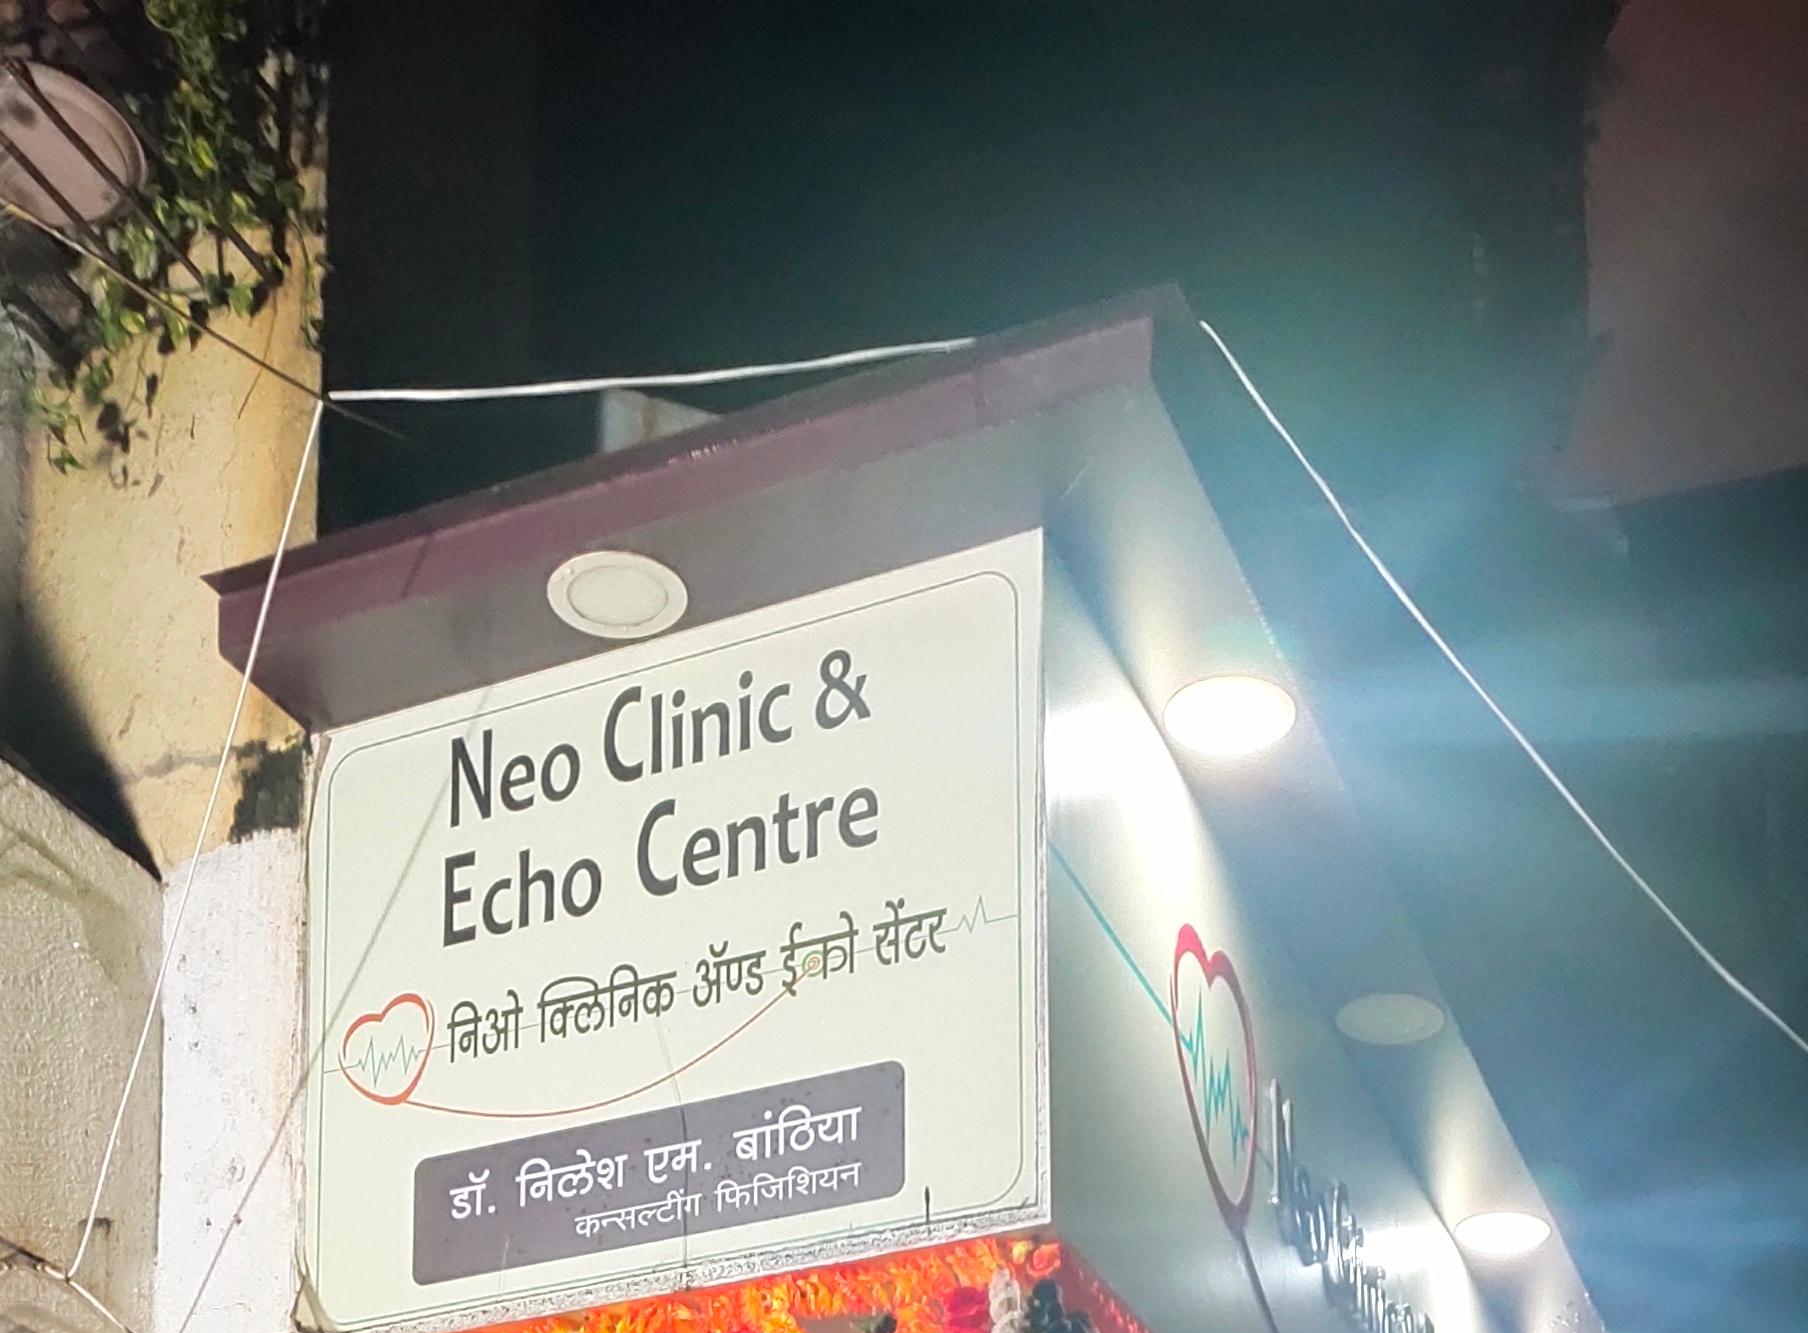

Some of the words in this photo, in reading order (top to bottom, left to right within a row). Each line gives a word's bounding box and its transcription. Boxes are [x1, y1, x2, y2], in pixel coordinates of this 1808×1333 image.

[449, 729, 580, 827] Neo
[603, 671, 791, 782] Clinic
[815, 649, 872, 731] &
[442, 846, 602, 947] Echo
[636, 784, 878, 896] Centre
[447, 989, 523, 1063] निओ
[537, 964, 677, 1043] क्लिनिक
[780, 911, 859, 996] ईको
[873, 898, 947, 965] सेंटर
[450, 1169, 496, 1219] डॉ.
[516, 1150, 628, 1207] निलेश
[644, 1139, 712, 1183] एम.
[733, 1105, 862, 1160] बांठिया
[575, 1188, 702, 1237] कन्सल्टींग
[716, 1162, 862, 1212] फिजिशियन
